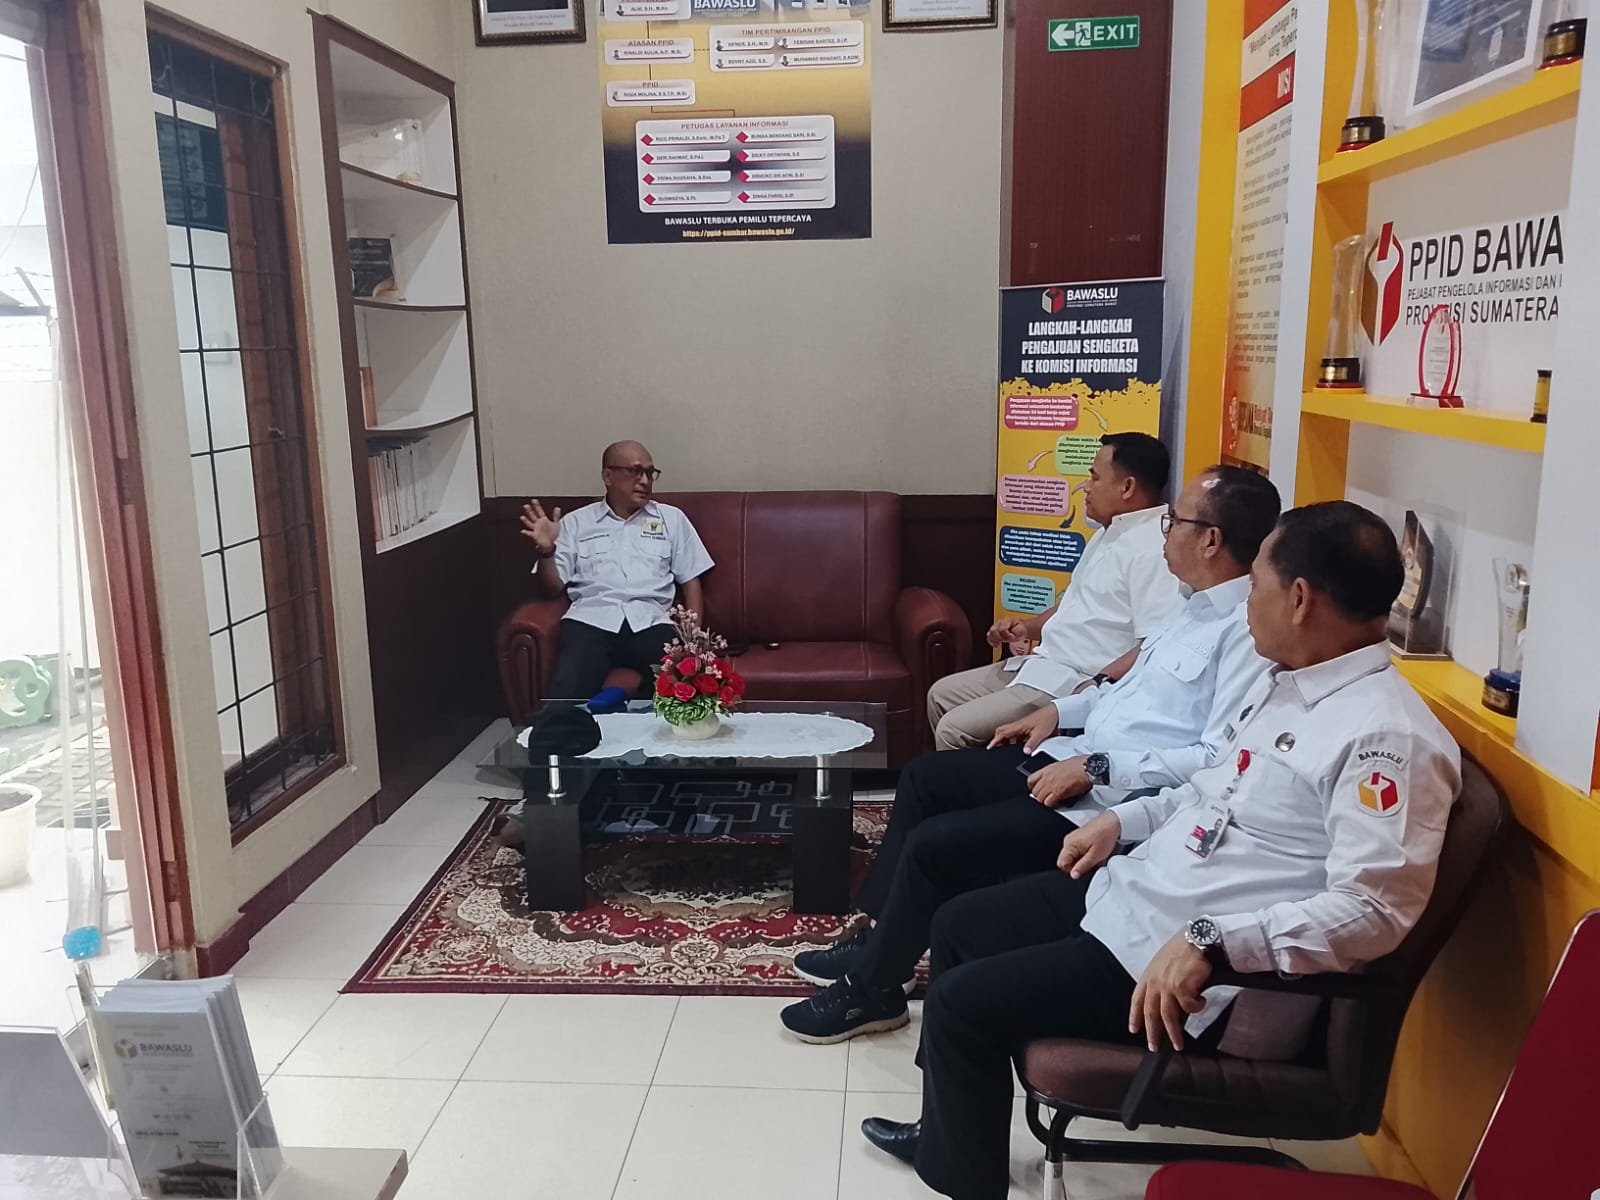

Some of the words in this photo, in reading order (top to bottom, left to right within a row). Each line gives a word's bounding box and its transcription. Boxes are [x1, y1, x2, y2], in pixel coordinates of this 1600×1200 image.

[1094, 24, 1137, 40] EXIT
[681, 122, 714, 130] PETUGAS
[750, 120, 788, 128] INFORMASI
[664, 217, 702, 226] BAWASLU
[702, 216, 738, 224] TERBUKA
[738, 216, 768, 224] PEMILU
[768, 214, 812, 224] TEPERCAYA
[1409, 234, 1464, 282] PPID
[1473, 215, 1564, 275] BAWA
[1066, 287, 1118, 300] BAWASLU
[1408, 286, 1436, 300] PEJABAT
[1438, 282, 1483, 298] PENGELOLA
[1485, 277, 1533, 294] INFORMASI
[1535, 274, 1556, 290] DAN
[1470, 295, 1559, 324] SUMATERA
[1028, 318, 1132, 336] LANGKAH-LANGKAH
[1022, 340, 1081, 355] PENGAJUAN
[1082, 338, 1139, 354] SENGKETA
[1021, 360, 1034, 373] KE
[1035, 359, 1074, 373] KOMISI
[1076, 358, 1138, 373] INFORMASI
[1358, 751, 1404, 764] BAWASLU
[140, 1043, 192, 1052] BAWASLU
